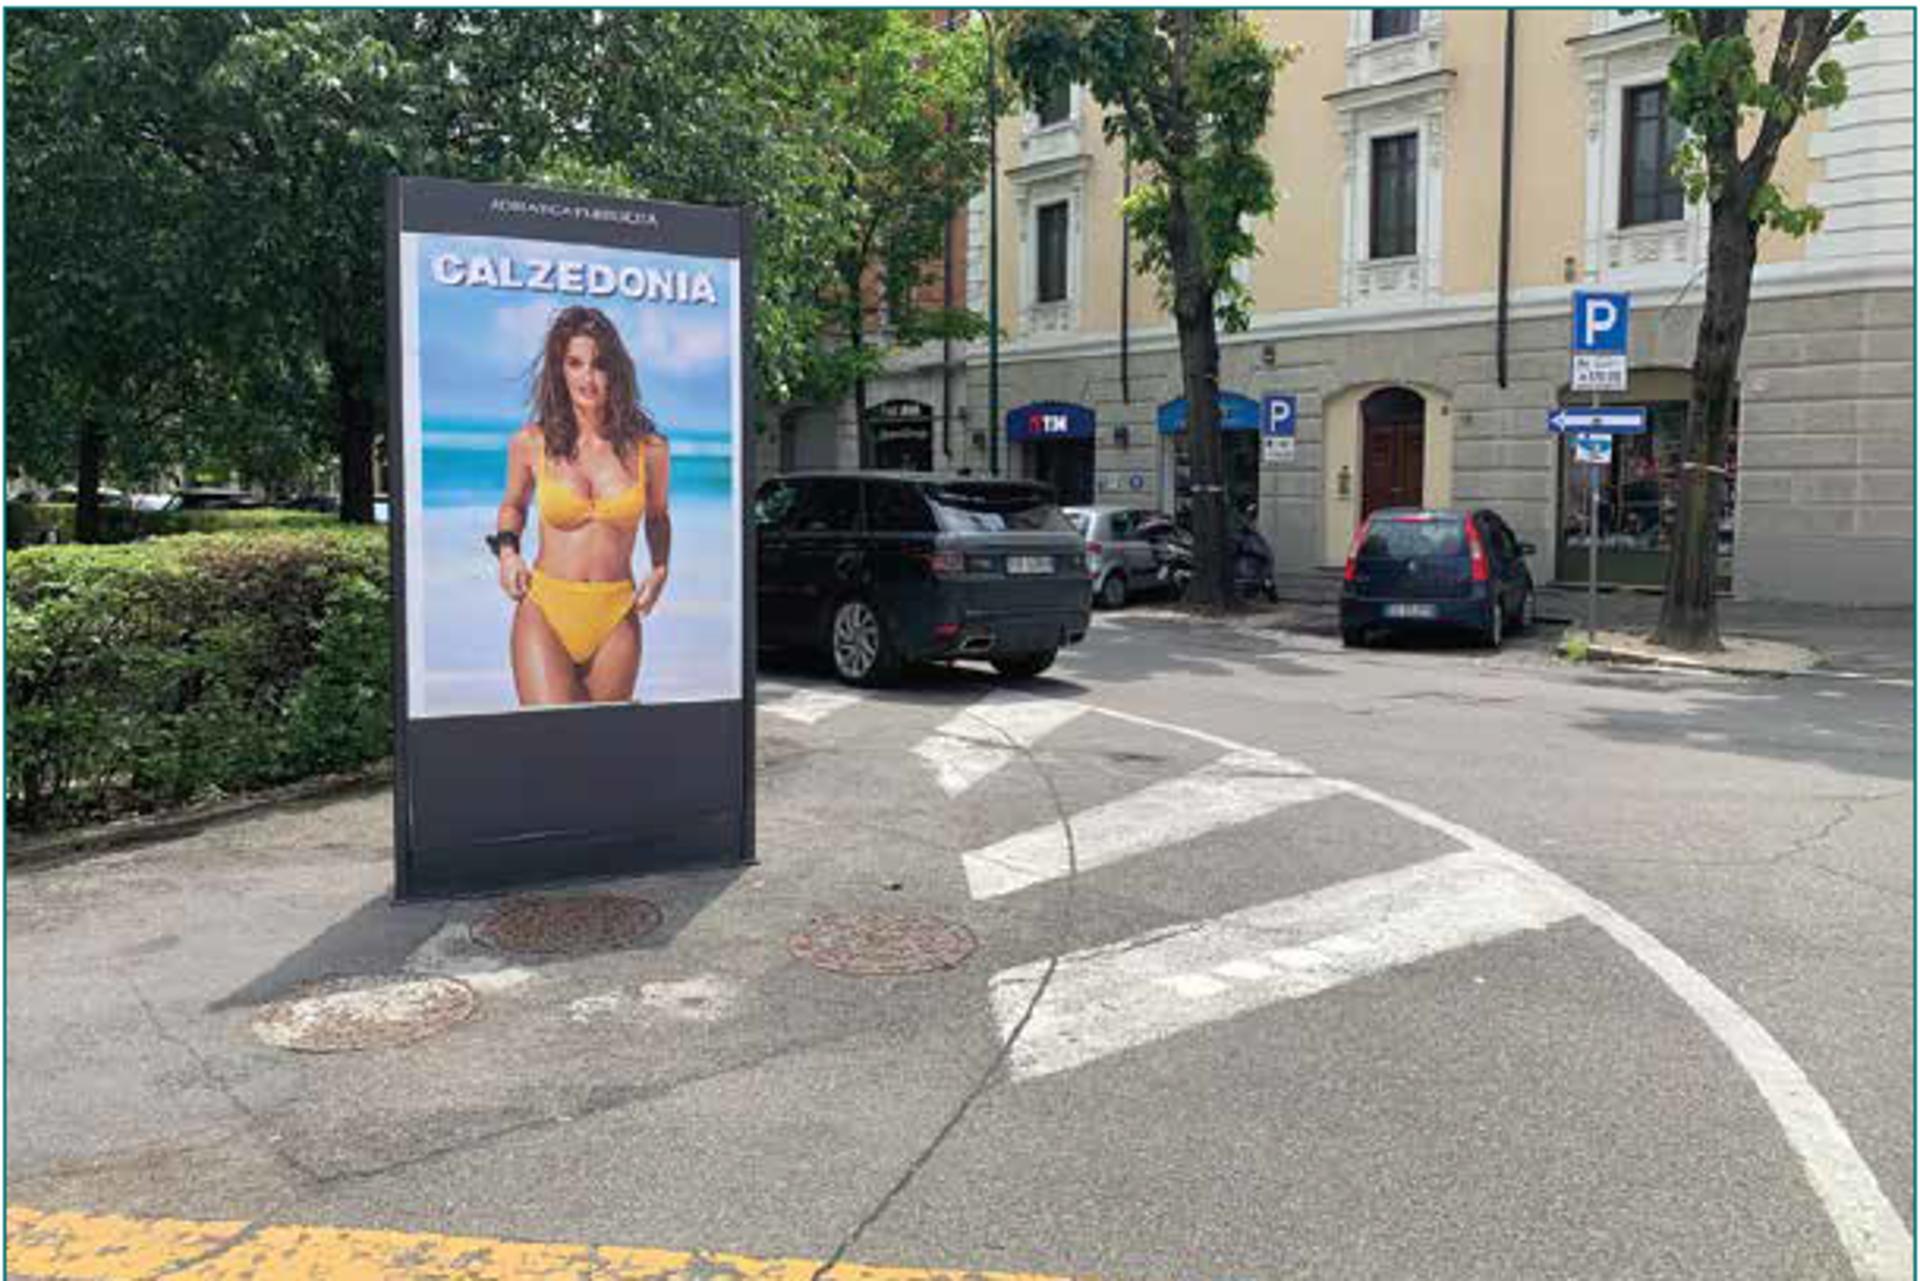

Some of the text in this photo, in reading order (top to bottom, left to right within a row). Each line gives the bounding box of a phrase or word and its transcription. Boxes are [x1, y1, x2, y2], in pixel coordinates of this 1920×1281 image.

[430, 253, 718, 304] CALZEDONIA
[1586, 299, 1617, 346] P
[1271, 399, 1291, 432] P
